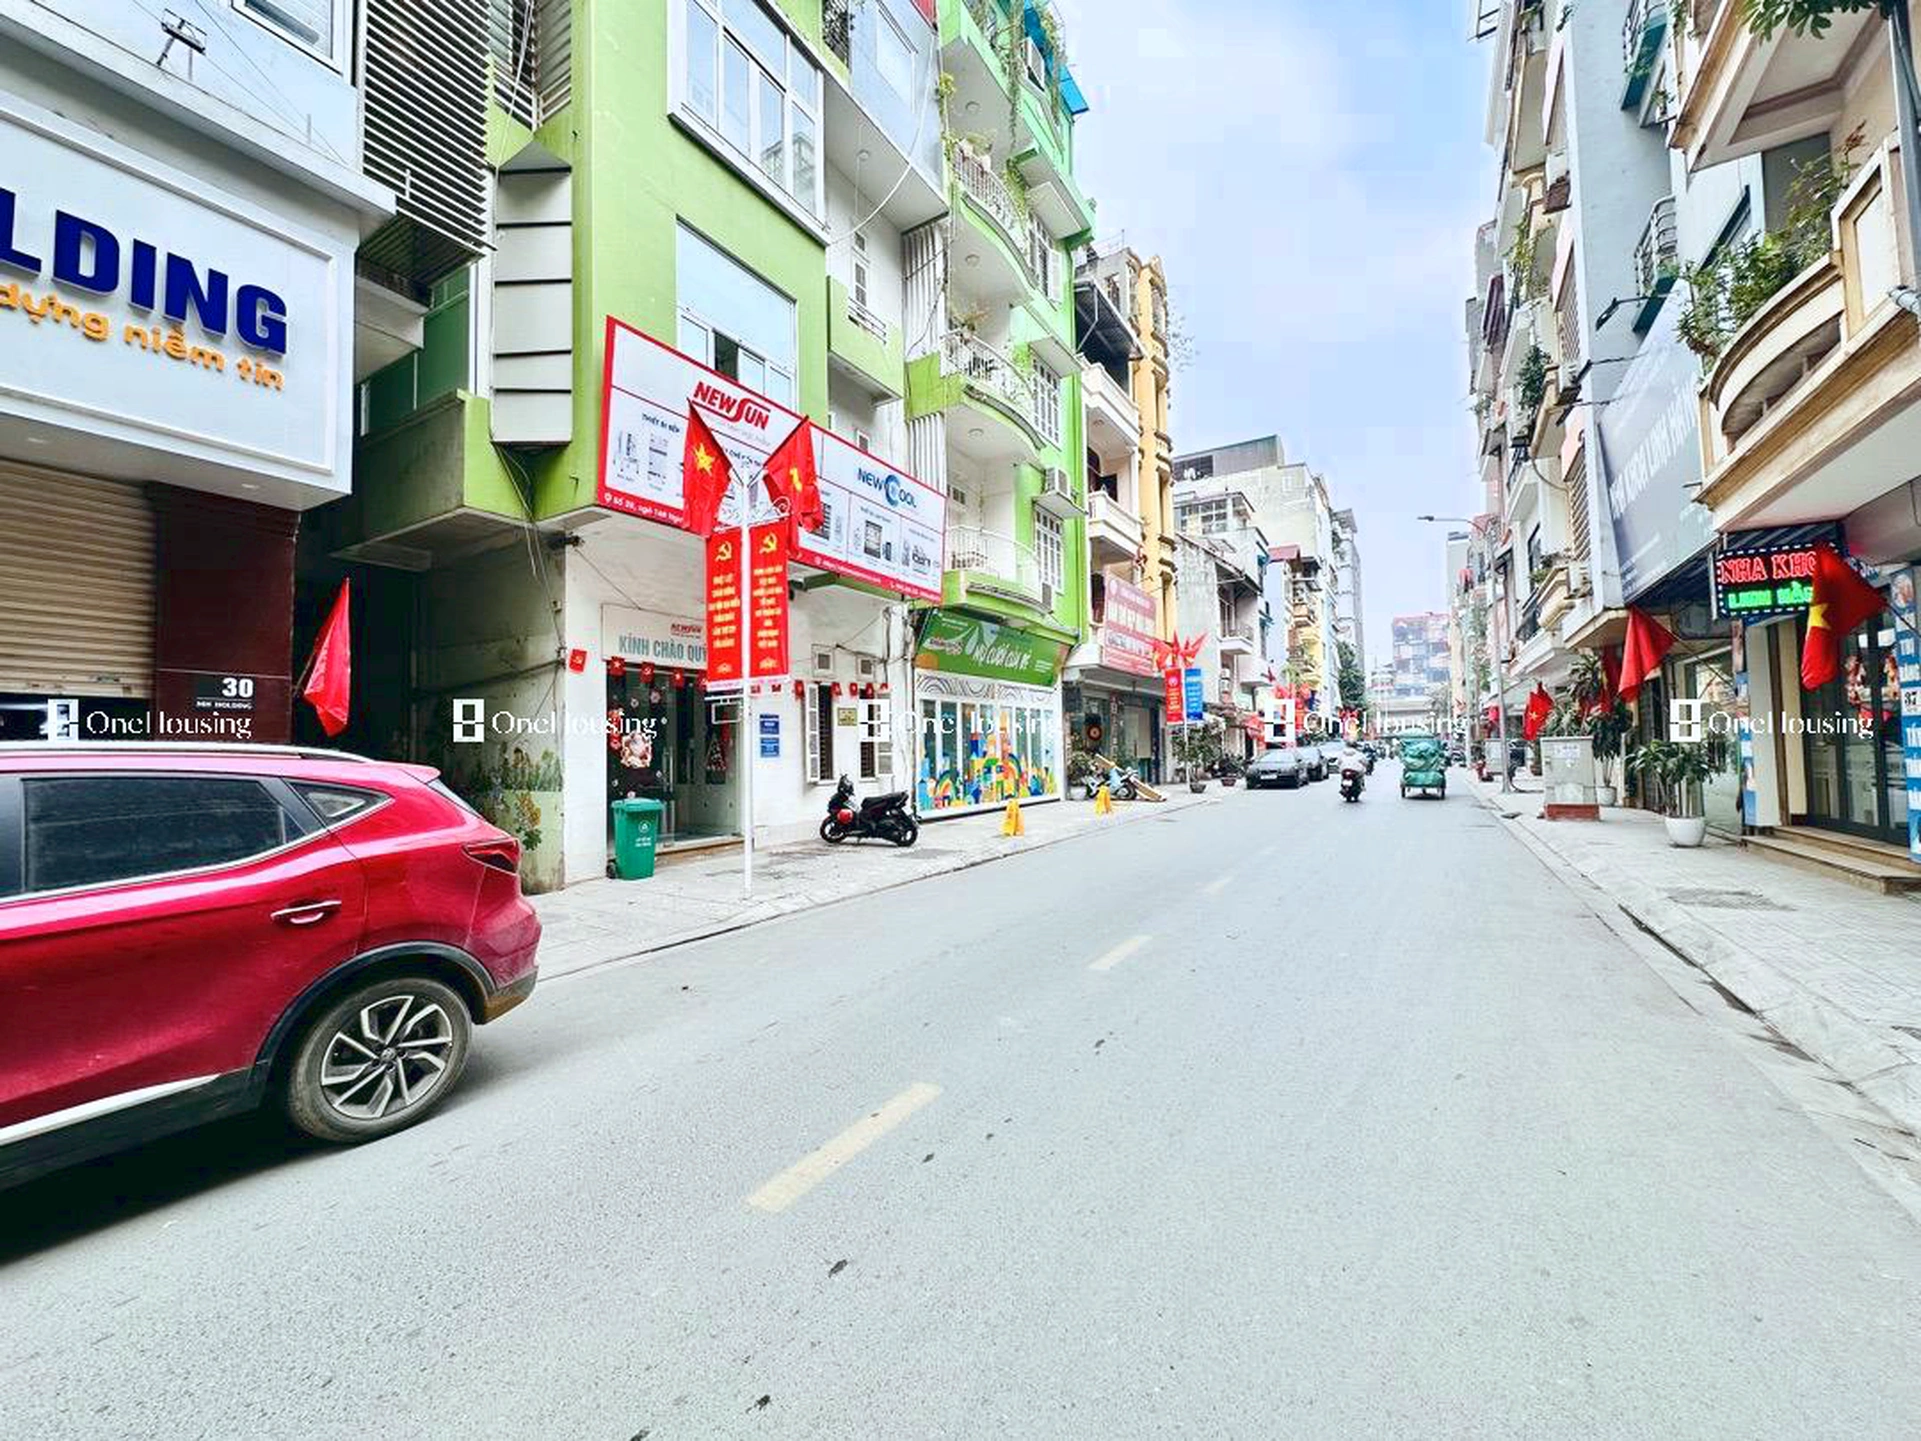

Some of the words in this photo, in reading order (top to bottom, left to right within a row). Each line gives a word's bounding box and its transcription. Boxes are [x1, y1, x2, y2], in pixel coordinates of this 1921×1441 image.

[236, 356, 285, 392] tin
[1720, 556, 1768, 585] NHA
[222, 677, 254, 698] 30
